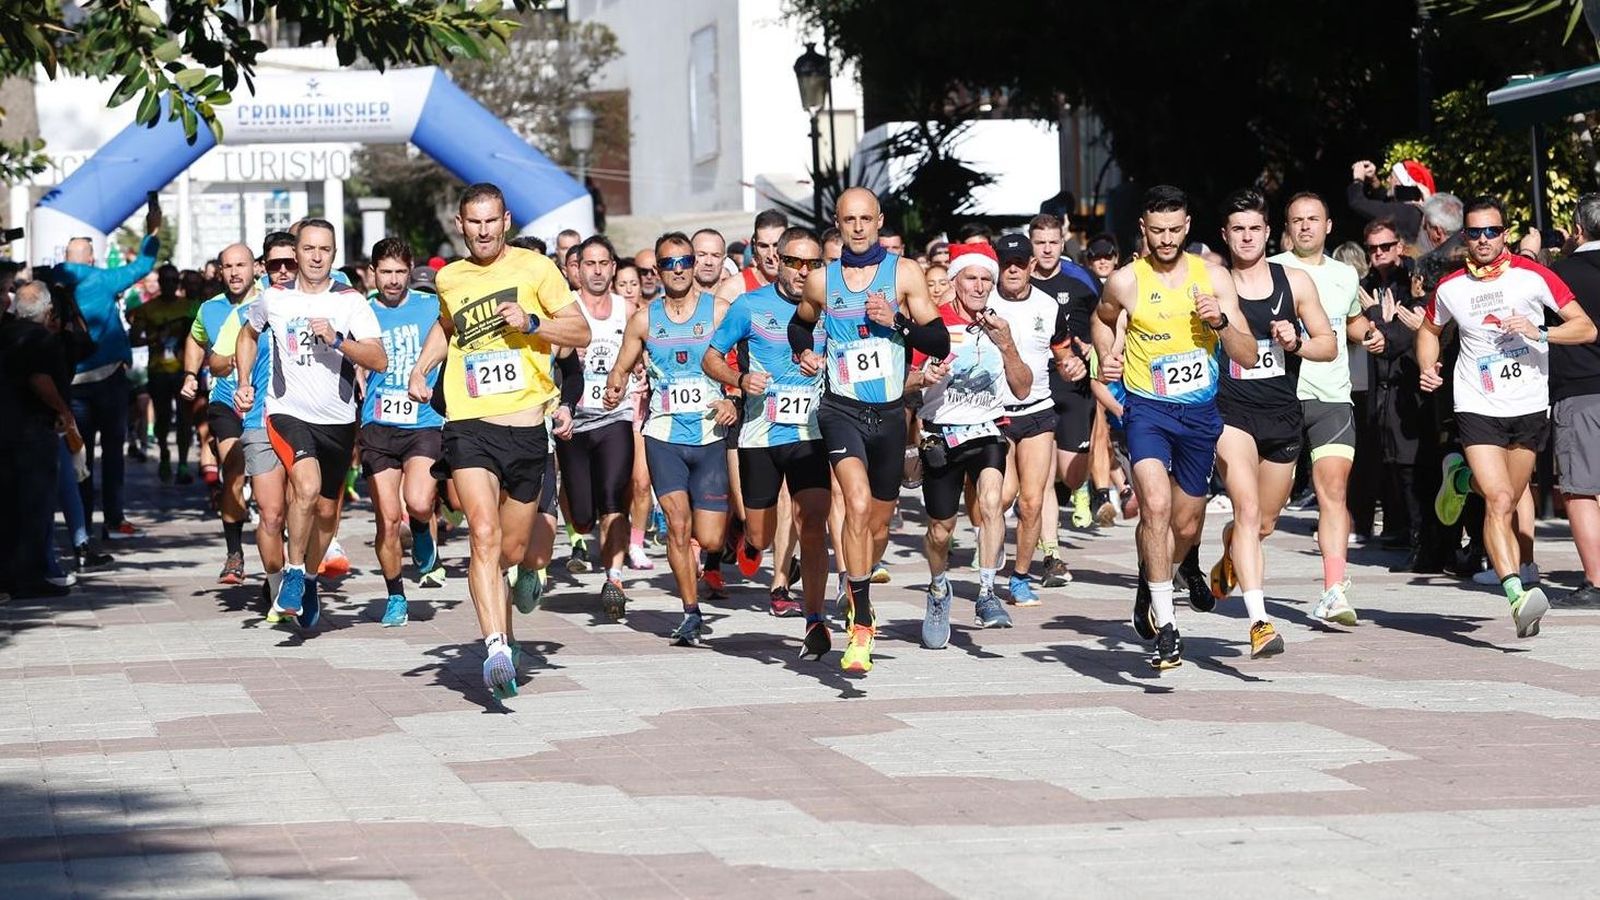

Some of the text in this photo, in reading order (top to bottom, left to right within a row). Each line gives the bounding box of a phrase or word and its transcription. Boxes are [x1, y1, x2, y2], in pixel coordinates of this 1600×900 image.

[237, 101, 391, 125] CRONOFINISHER
[217, 150, 347, 181] TURISMO
[1476, 291, 1504, 304] CARRERA
[463, 298, 498, 330] XIII
[393, 324, 420, 342] SAN
[395, 337, 422, 355] SIL
[857, 351, 880, 371] 81
[479, 363, 517, 384] 218
[1167, 362, 1203, 384] 232
[1500, 362, 1522, 380] 48
[671, 388, 702, 404] 103
[383, 399, 413, 415] 219
[779, 397, 811, 414] 217
